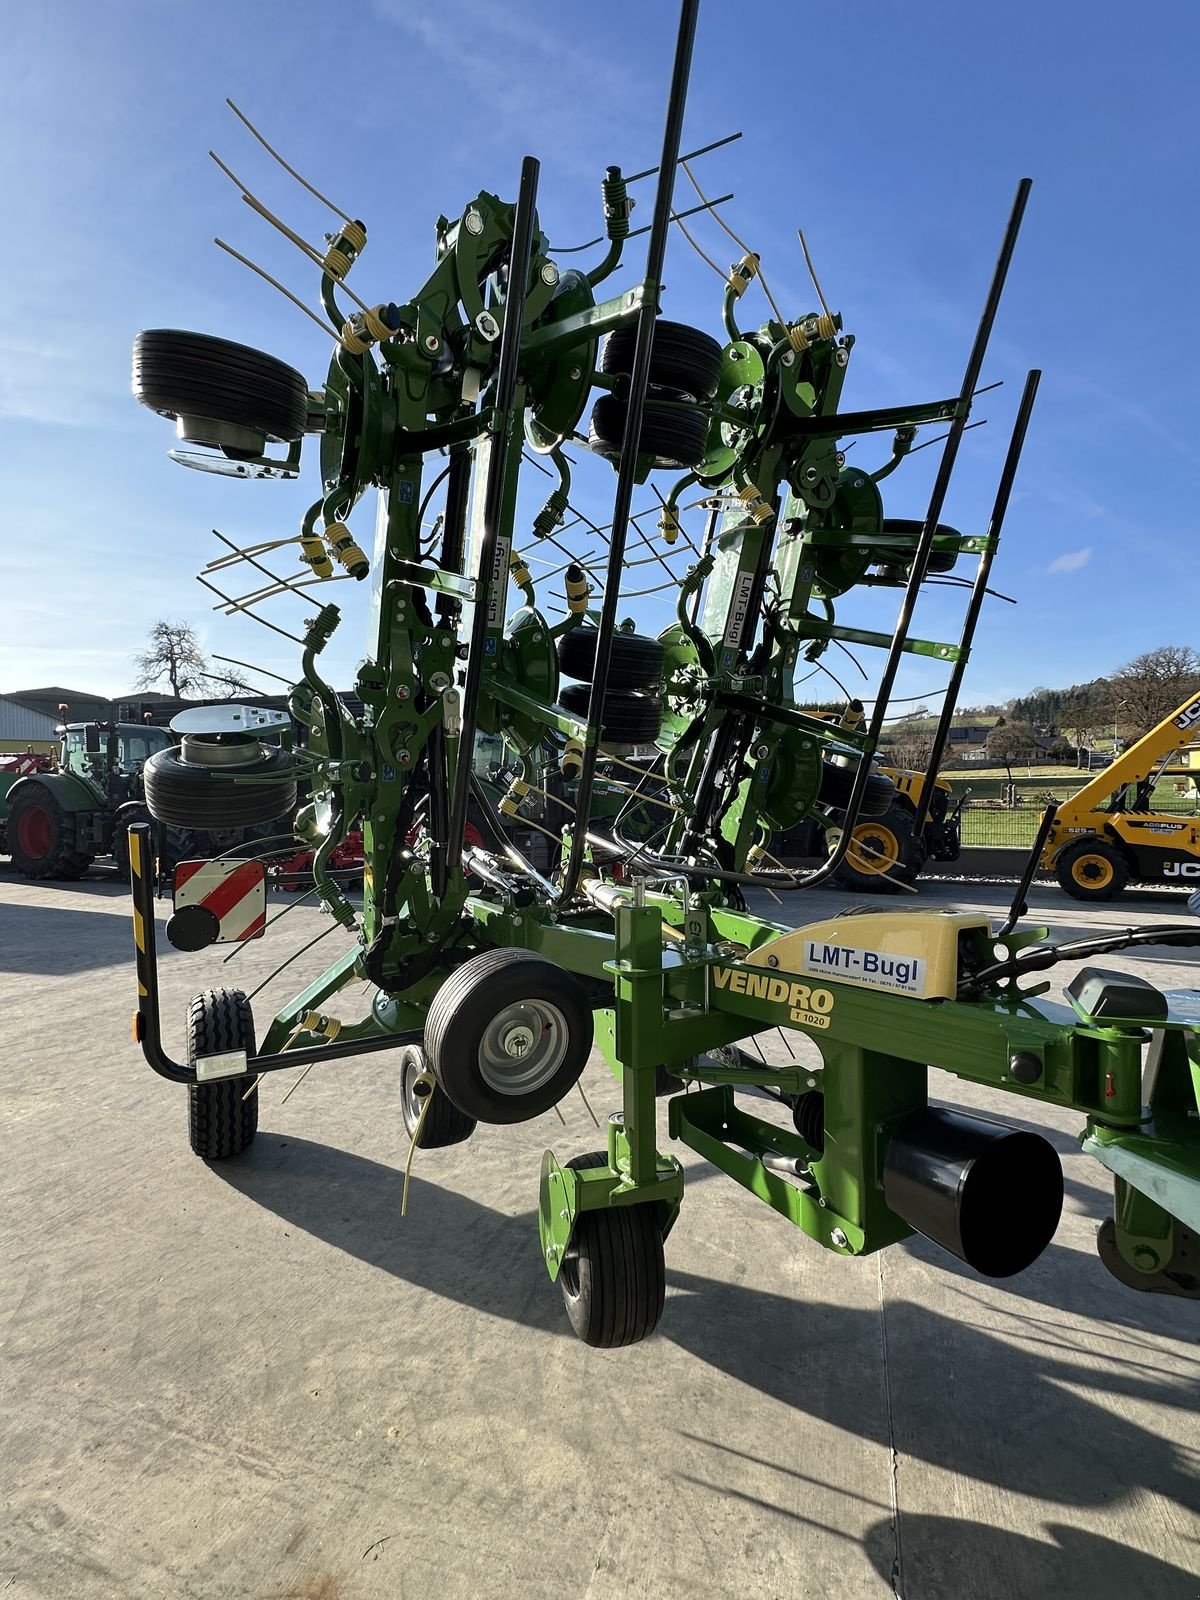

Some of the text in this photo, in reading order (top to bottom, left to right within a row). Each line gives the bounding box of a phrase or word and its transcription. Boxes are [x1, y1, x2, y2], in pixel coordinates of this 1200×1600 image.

[729, 576, 752, 644] LMT-Bugl
[1177, 699, 1200, 729] JC
[809, 943, 918, 984] LMT-Bugl
[712, 966, 835, 1014] VENDRO
[795, 1012, 825, 1026] T 1020
